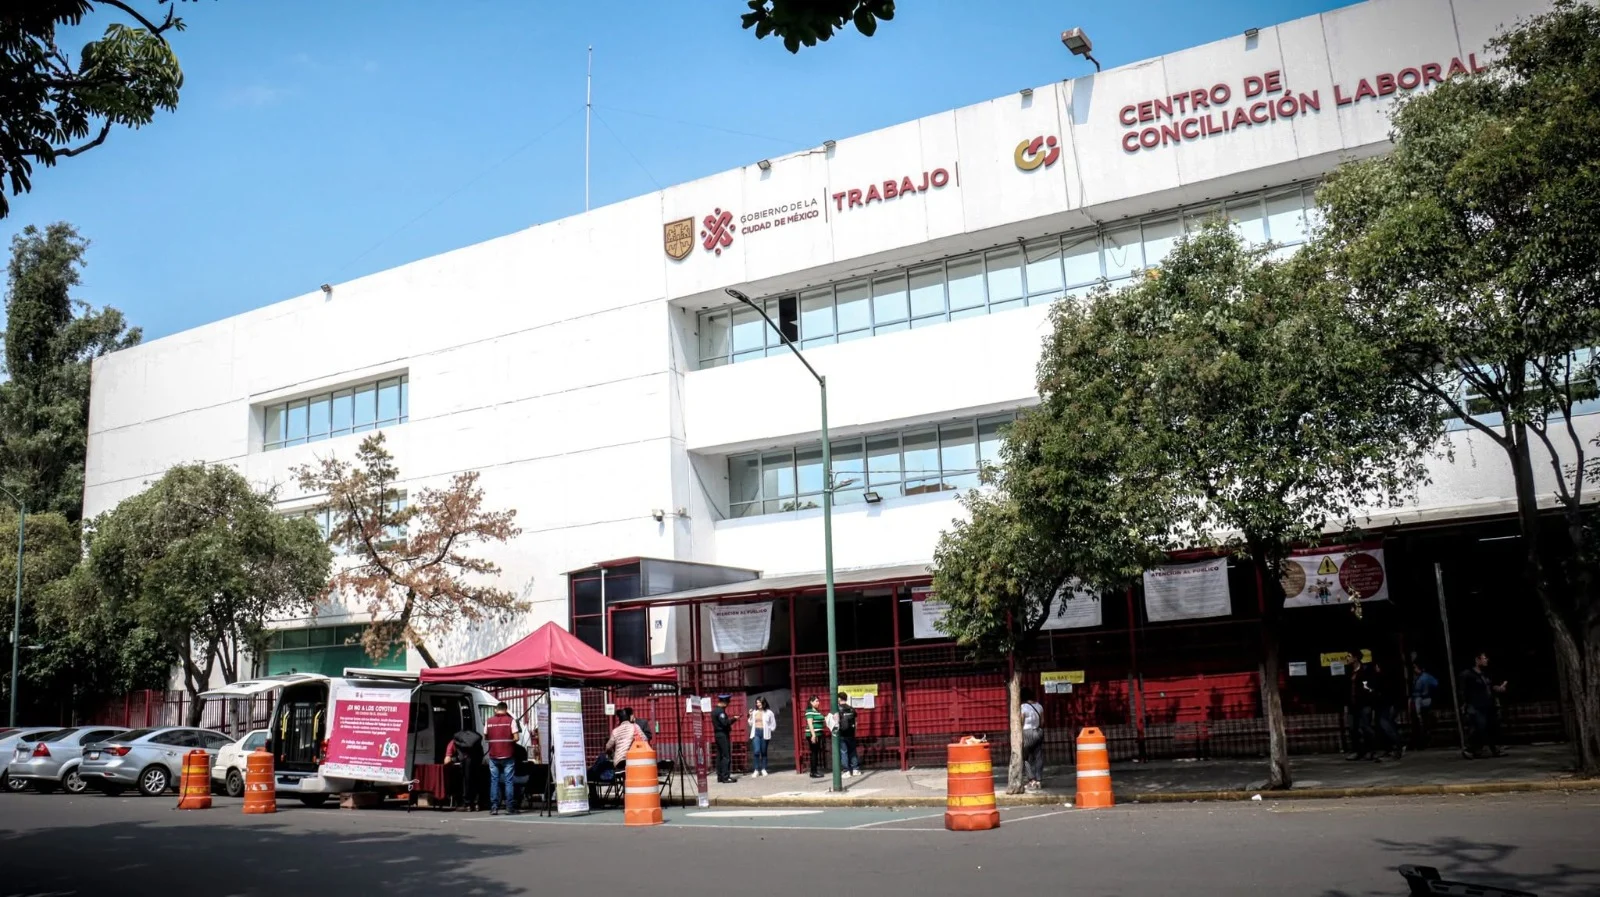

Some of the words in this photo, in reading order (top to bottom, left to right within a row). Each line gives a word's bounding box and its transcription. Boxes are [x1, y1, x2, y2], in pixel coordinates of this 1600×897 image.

[1119, 83, 1231, 126] CENTRO
[1243, 70, 1282, 98] DE
[1122, 89, 1320, 152] CONCILIACIÓN
[1334, 53, 1488, 106] LABORAL
[740, 204, 788, 224] GOBIERNO
[790, 201, 802, 211] DE
[804, 198, 818, 208] LA
[832, 168, 949, 212] TRABAJO
[742, 218, 772, 235] CIUDAD
[774, 216, 786, 227] DE
[787, 210, 819, 225] MÉXICO
